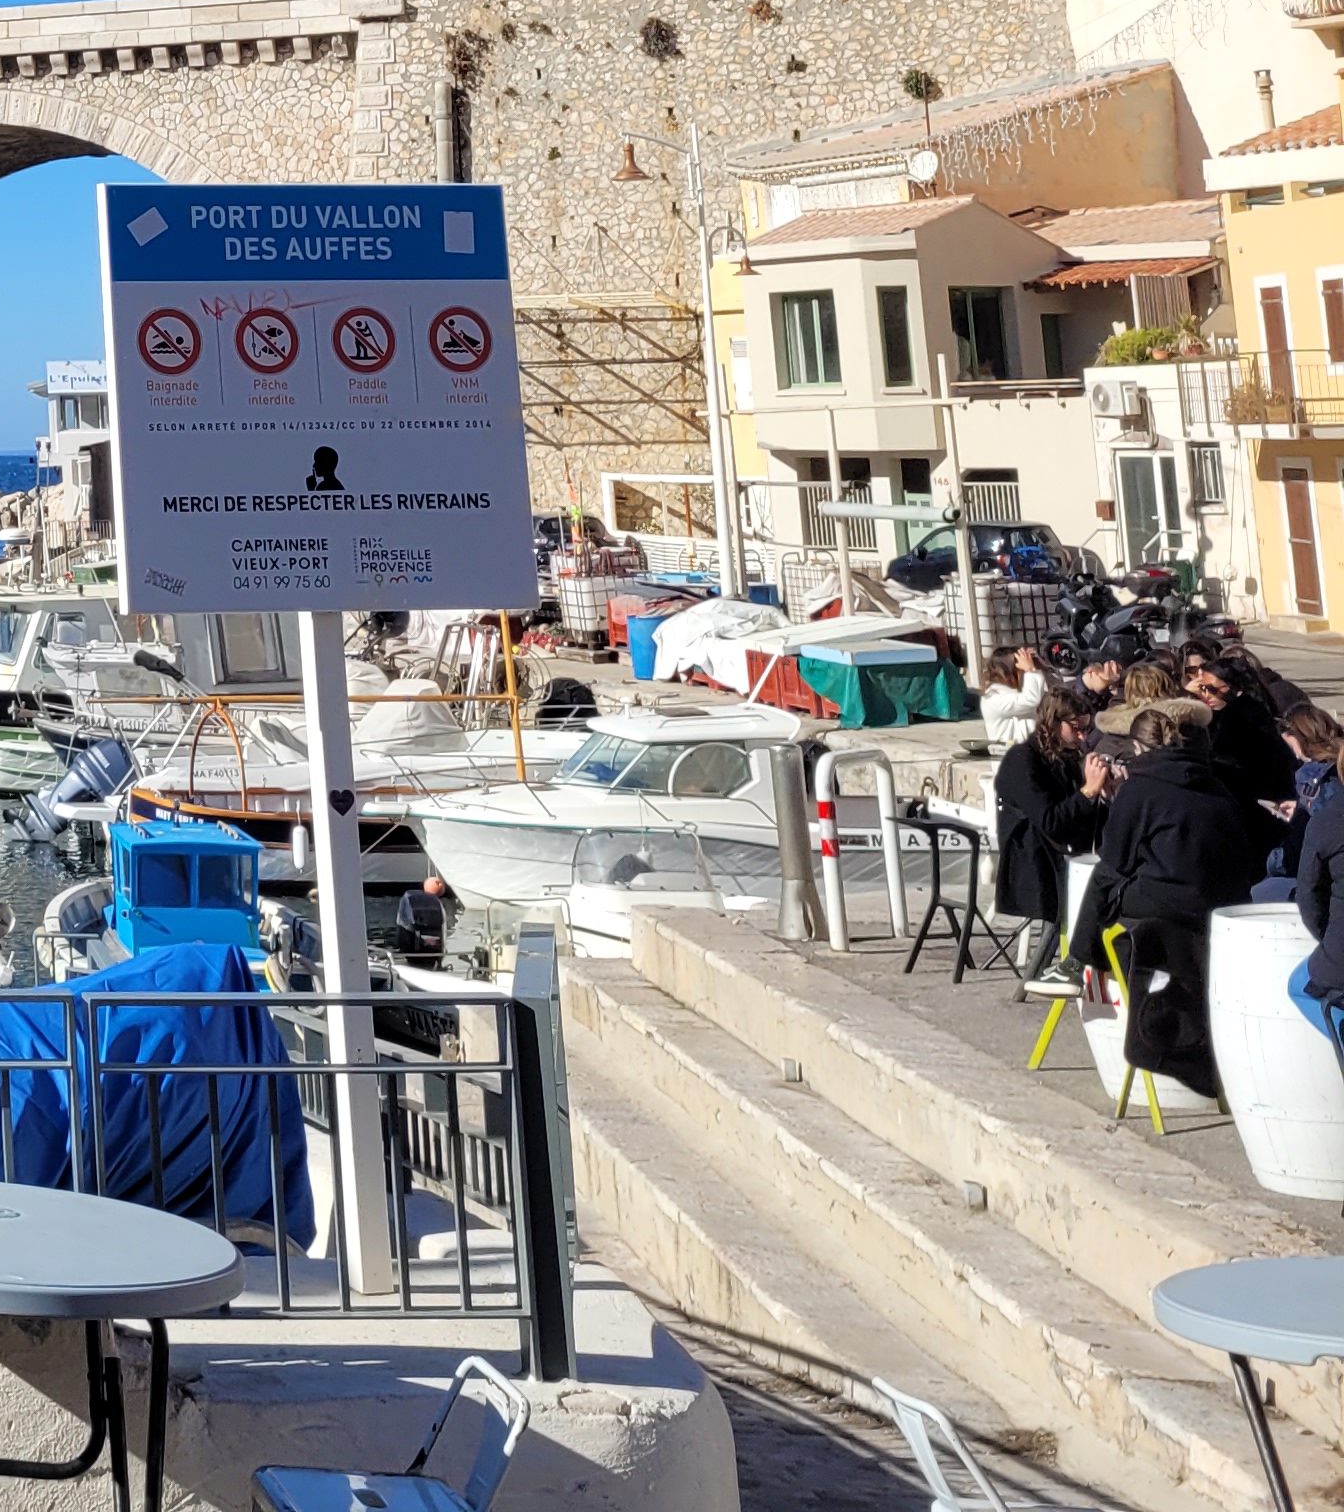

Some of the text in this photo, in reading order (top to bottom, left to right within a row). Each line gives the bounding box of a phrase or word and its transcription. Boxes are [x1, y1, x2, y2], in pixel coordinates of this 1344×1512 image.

[190, 204, 422, 229] PORT DU VALLON
[224, 236, 393, 261] DES AUFFES
[146, 379, 199, 394] Baignade
[253, 379, 288, 391] Pêche
[348, 378, 387, 390] Paddle
[451, 377, 479, 389] VNM
[149, 394, 198, 407] interdite
[248, 394, 295, 406] interdite
[348, 392, 389, 405] interdit
[445, 392, 489, 404] interdit
[148, 419, 492, 432] SELON ARRETÉ DIPOR 14/12342/CC DU 22 DECEMBRE 2014
[163, 492, 491, 513] MERCI DE RESPECTER LES RIVERAINS
[230, 538, 329, 553] CAPITAINERIE
[359, 537, 383, 548] AIX
[360, 548, 432, 561] MARSEILLE
[232, 556, 329, 571] VIEUX-PORT
[360, 561, 433, 574] PROVENCE
[233, 574, 331, 590] 04 91 99 75 60
